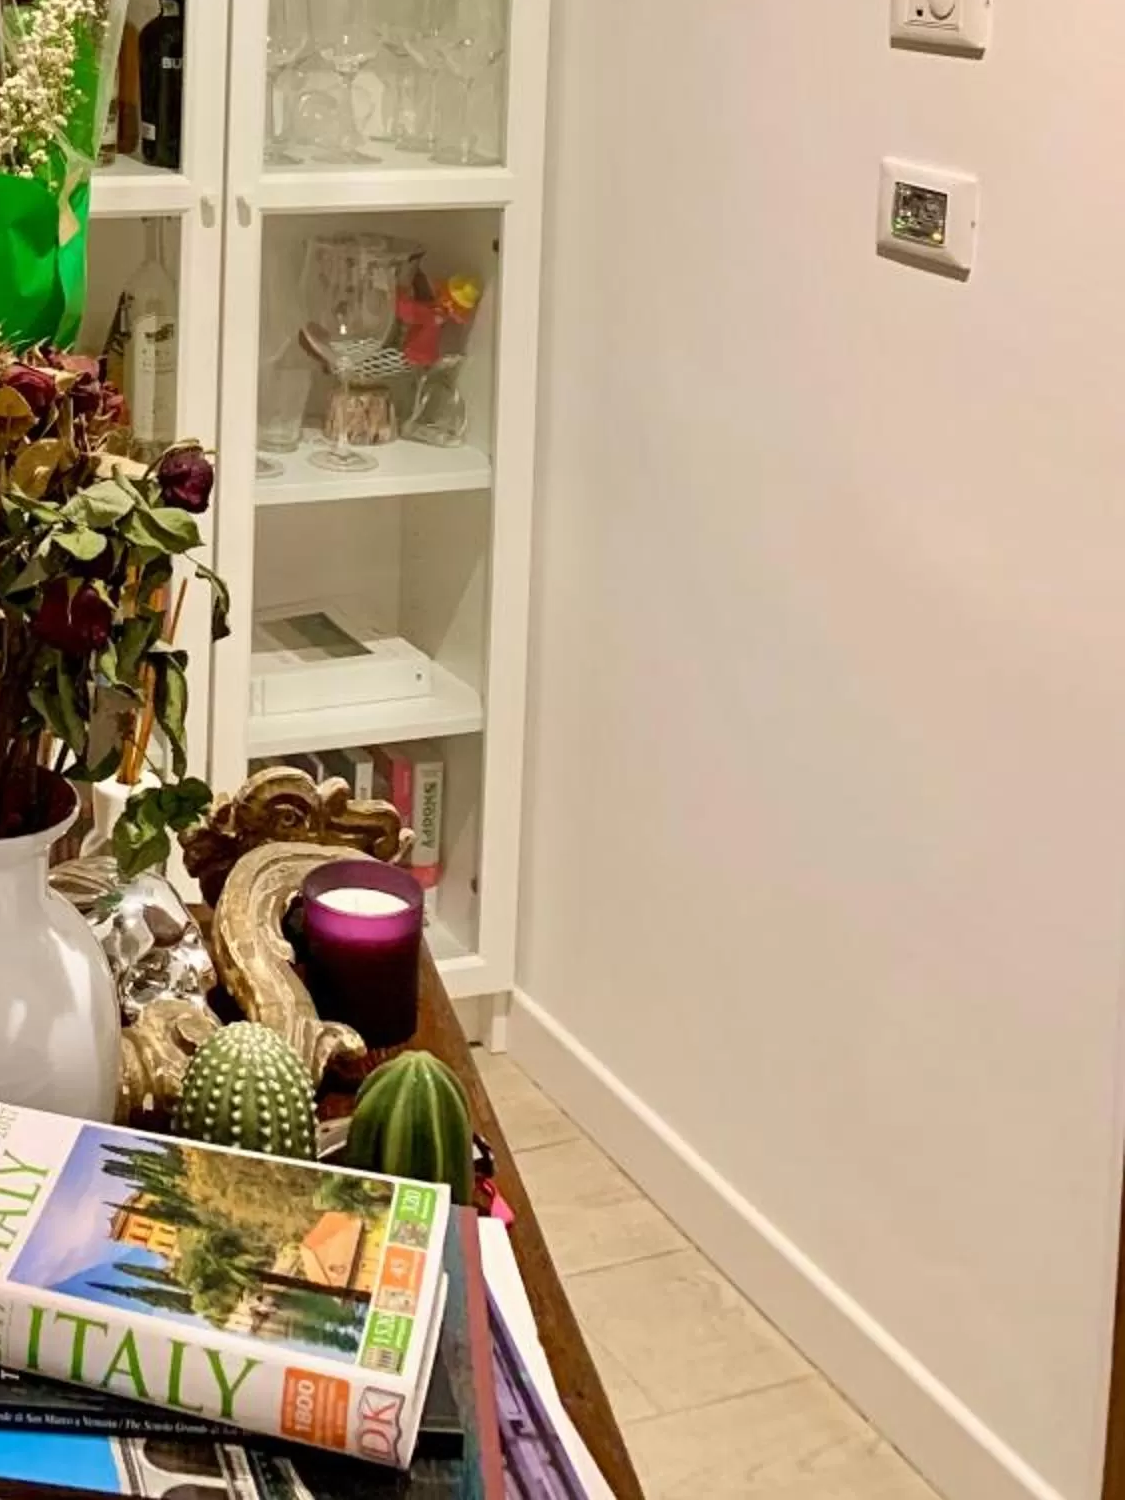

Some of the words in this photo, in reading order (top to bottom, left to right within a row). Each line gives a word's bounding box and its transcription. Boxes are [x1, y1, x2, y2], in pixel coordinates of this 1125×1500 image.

[422, 781, 438, 848] SNOOPY
[27, 1305, 263, 1419] ITALY
[294, 1379, 316, 1432] 1800
[359, 1401, 397, 1460] DK
